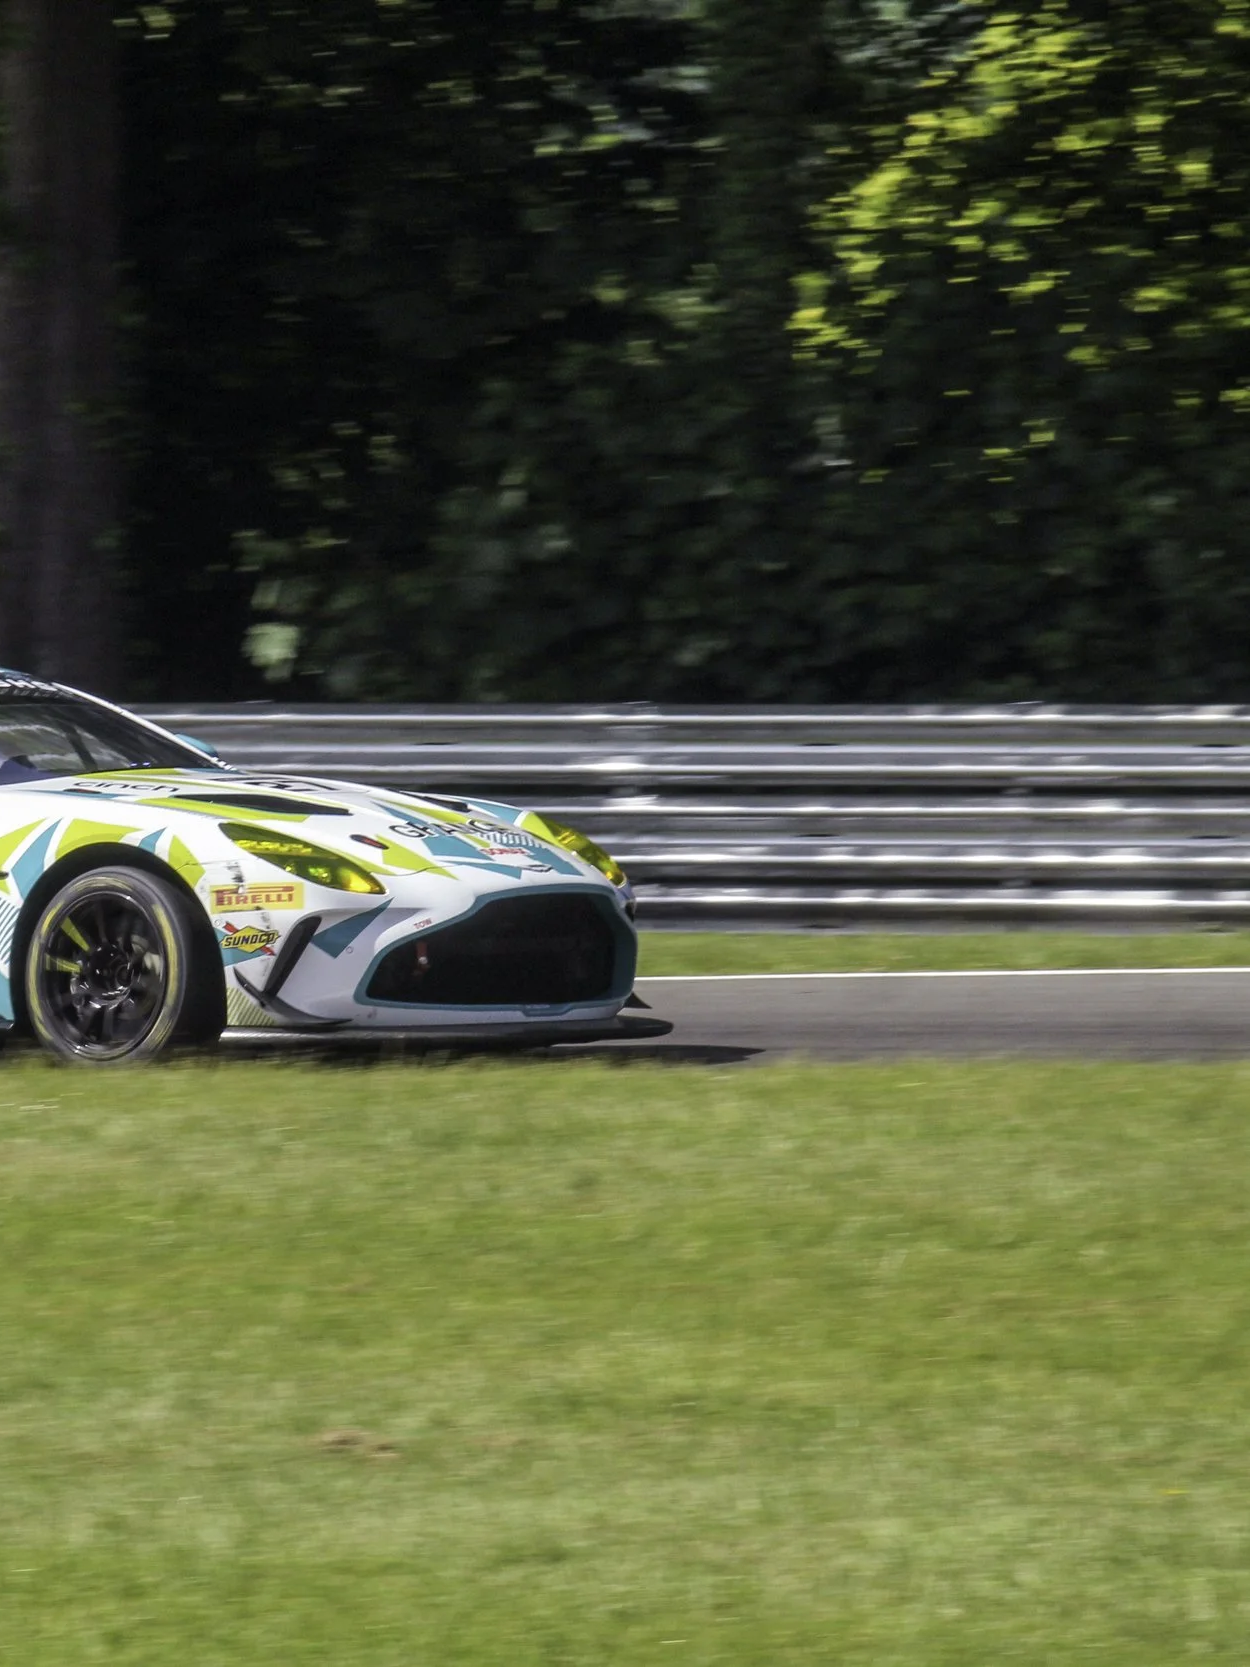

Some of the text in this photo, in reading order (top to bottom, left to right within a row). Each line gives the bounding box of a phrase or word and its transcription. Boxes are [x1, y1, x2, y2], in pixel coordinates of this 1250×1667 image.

[73, 781, 180, 792] cinch
[212, 886, 295, 906] PIRELLI
[224, 932, 277, 947] SUNOCO
